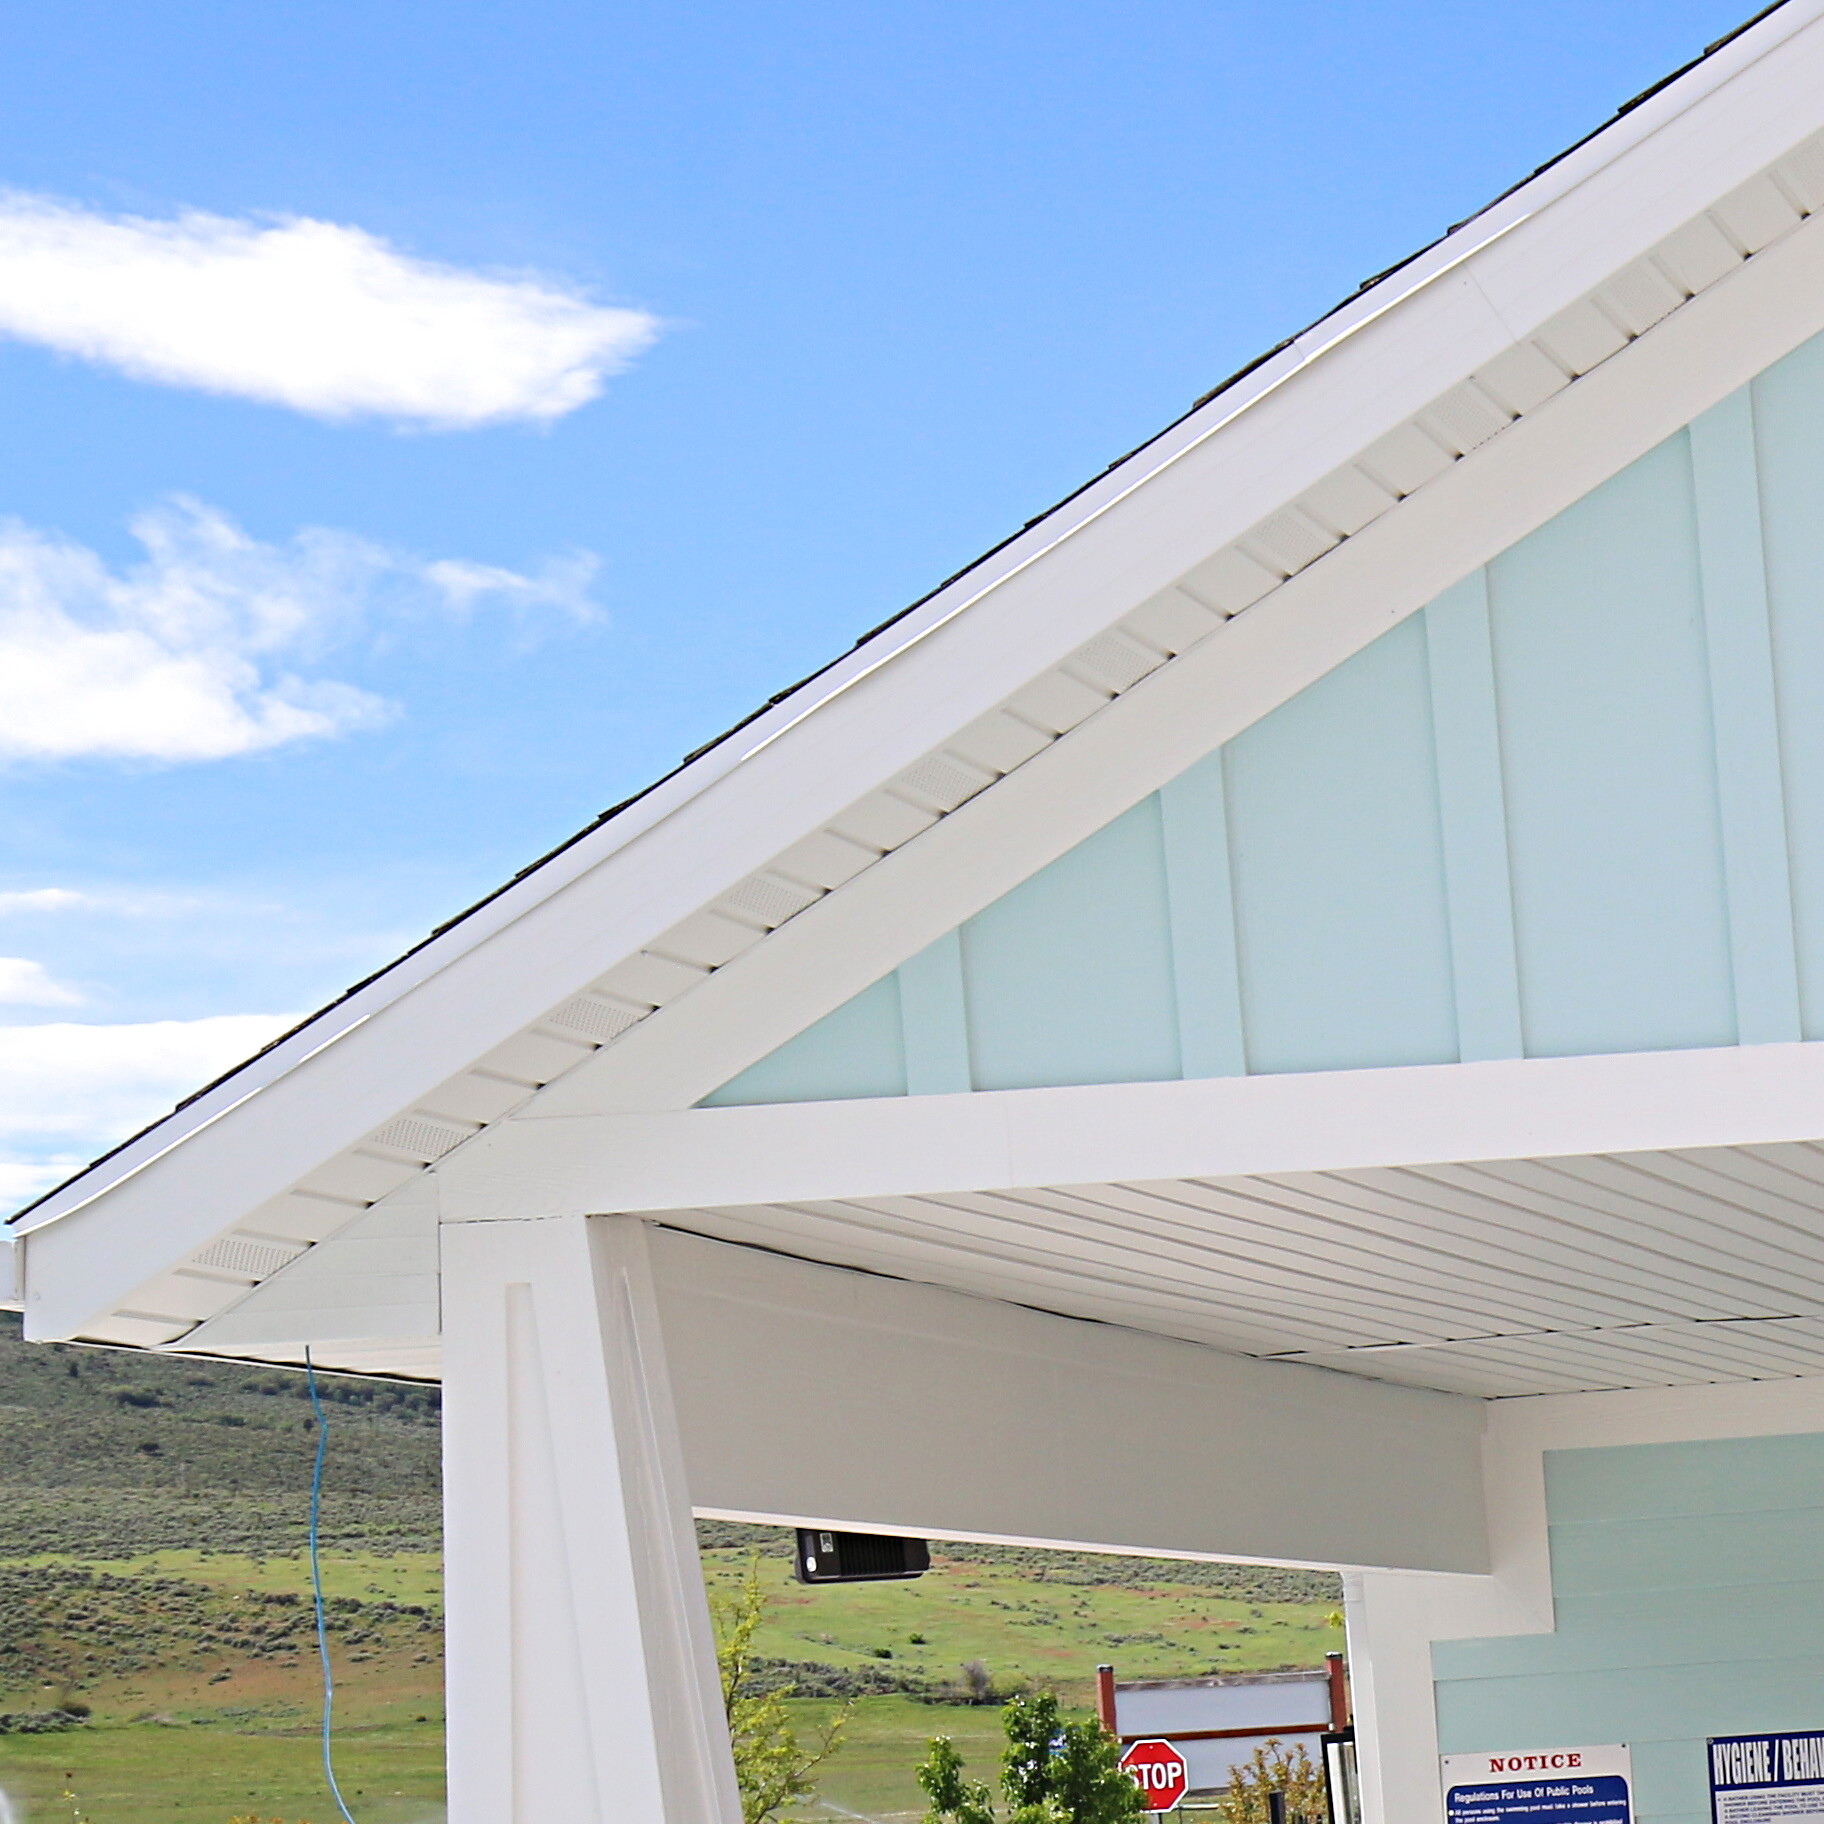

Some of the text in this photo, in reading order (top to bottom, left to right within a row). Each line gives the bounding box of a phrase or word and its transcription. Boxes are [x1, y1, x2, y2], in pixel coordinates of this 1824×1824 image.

[1489, 1752, 1581, 1772] NOTICE
[1712, 1739, 1771, 1785] HYGIENE
[1771, 1738, 1781, 1782] /
[1126, 1761, 1182, 1790] STOP
[1453, 1783, 1594, 1805] Regulations For Use Of Public Pools
